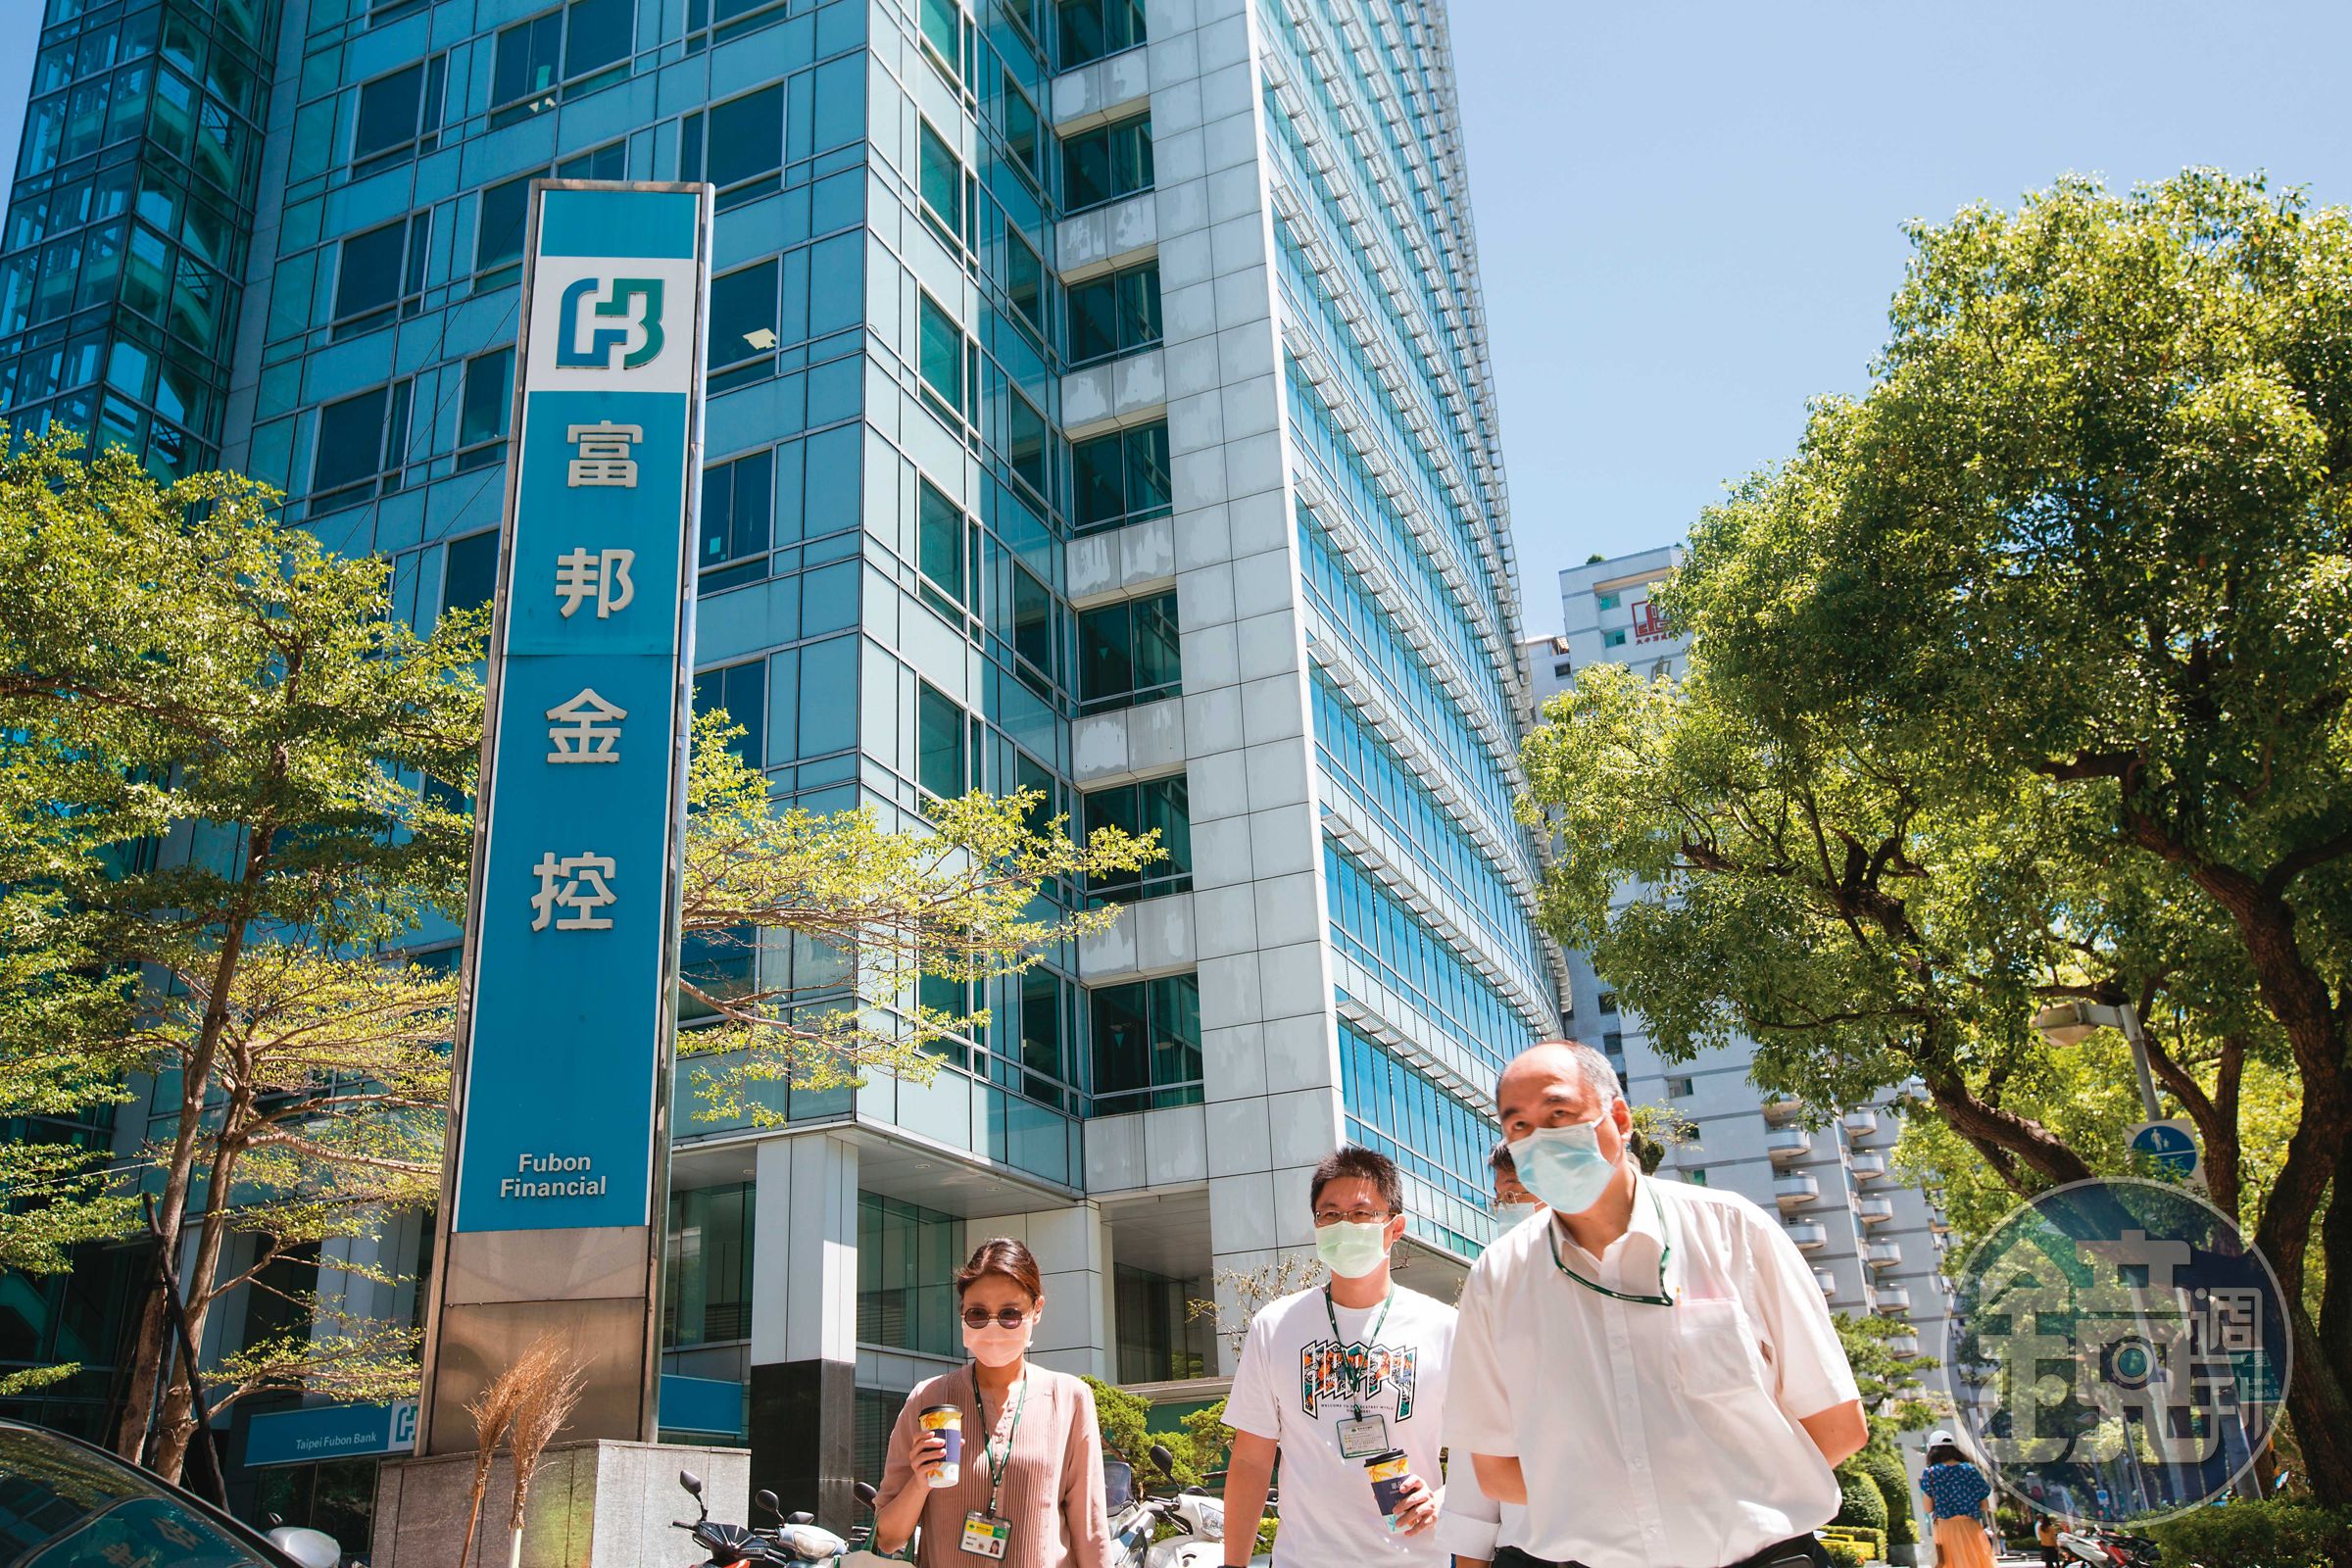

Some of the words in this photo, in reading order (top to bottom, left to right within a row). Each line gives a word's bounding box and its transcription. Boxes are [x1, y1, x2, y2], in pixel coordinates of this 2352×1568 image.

[531, 419, 644, 932] 富邦金控
[518, 1152, 591, 1173] Fubon
[500, 1176, 607, 1198] Financial
[296, 1437, 322, 1450] Taipei
[323, 1436, 352, 1447] Fubon
[354, 1432, 376, 1444] Bank
